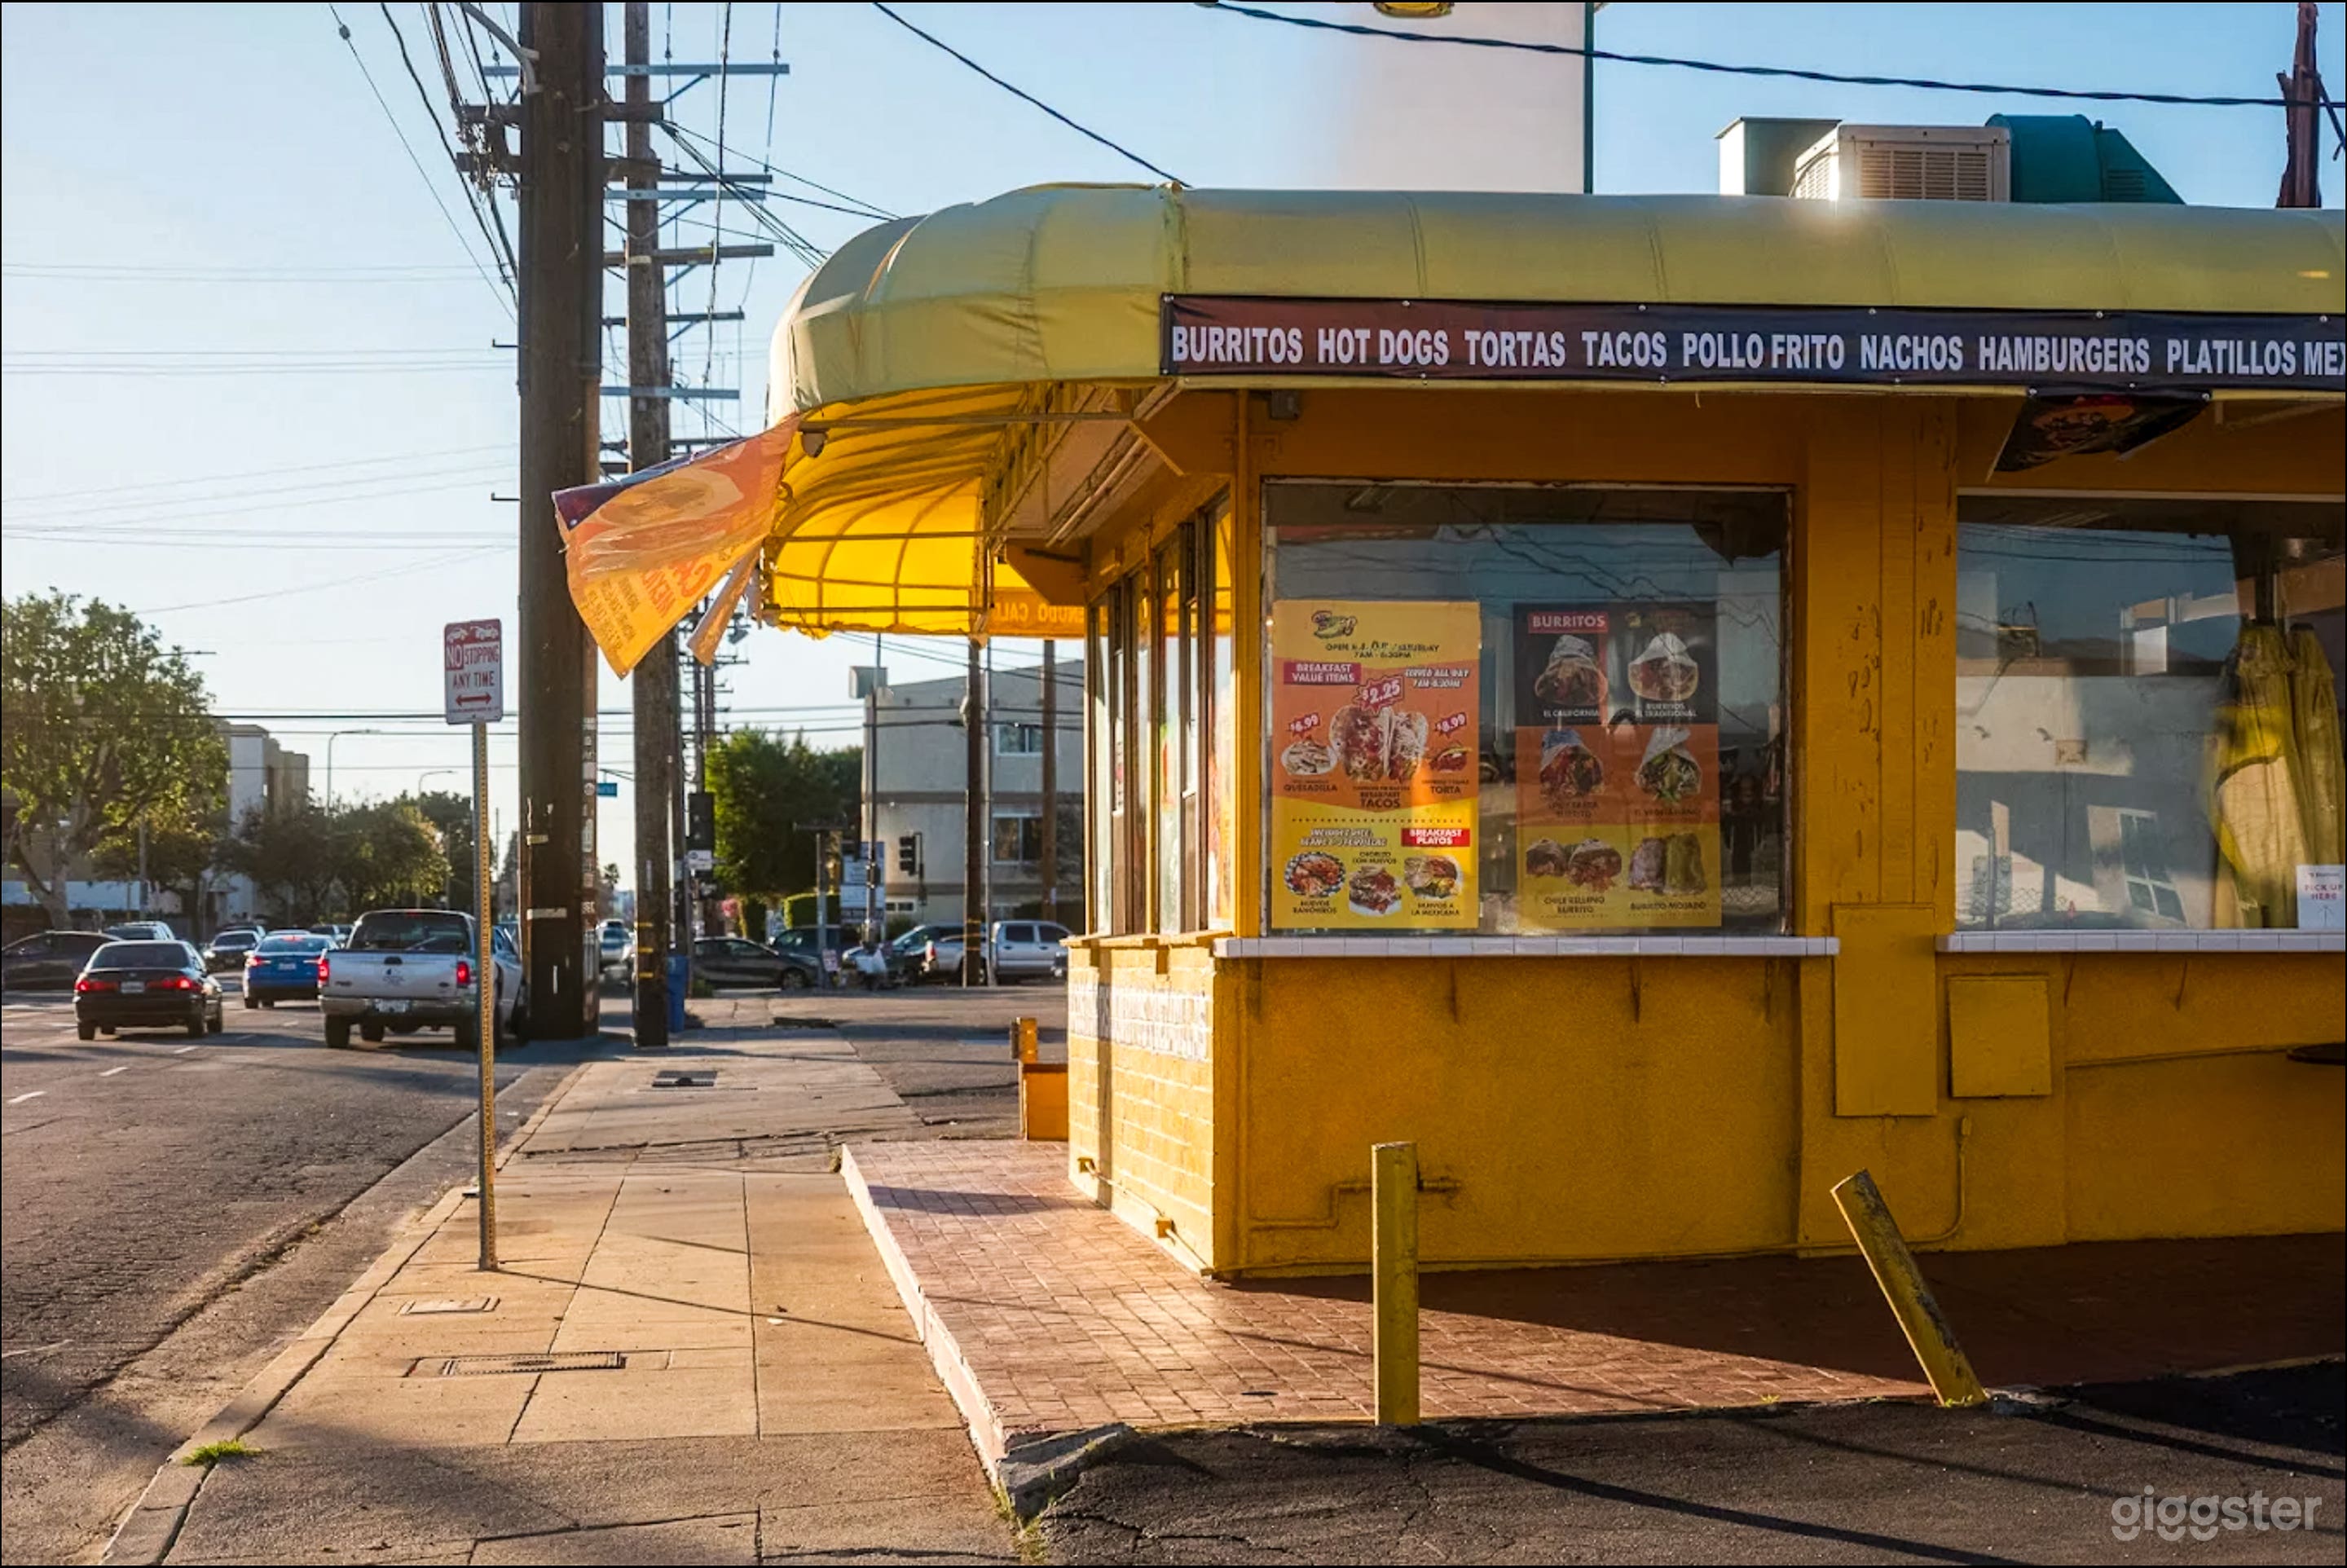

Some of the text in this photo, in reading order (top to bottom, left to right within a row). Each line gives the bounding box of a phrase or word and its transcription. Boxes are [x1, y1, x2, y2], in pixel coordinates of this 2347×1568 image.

[1172, 326, 1303, 364] BURRITOS
[1317, 328, 1371, 364] HOT
[1379, 328, 1449, 366] DOGS
[1464, 329, 1566, 367] TORTAS
[1581, 331, 1667, 368] TACOS
[1682, 333, 1764, 369] POLLO
[1770, 334, 1845, 370] FRITO
[1860, 335, 1963, 371] NACHOS
[1978, 336, 2150, 373] HAMBURGERS
[2166, 338, 2296, 376] PLATILLOS
[1532, 615, 1605, 628] BURRITOS
[446, 644, 500, 668] NO STOPPING
[1296, 663, 1351, 673] BREAKFAST
[1434, 668, 1449, 677] ALL
[453, 670, 495, 689] ANY TIME
[1291, 673, 1355, 683] VALUE ITEMS
[1361, 679, 1401, 704] $2.25
[1283, 784, 1338, 792] QUESADILLA
[1430, 786, 1461, 794] TORTA
[1360, 799, 1401, 808] TACOS
[1410, 829, 1462, 837] BREAKFAST
